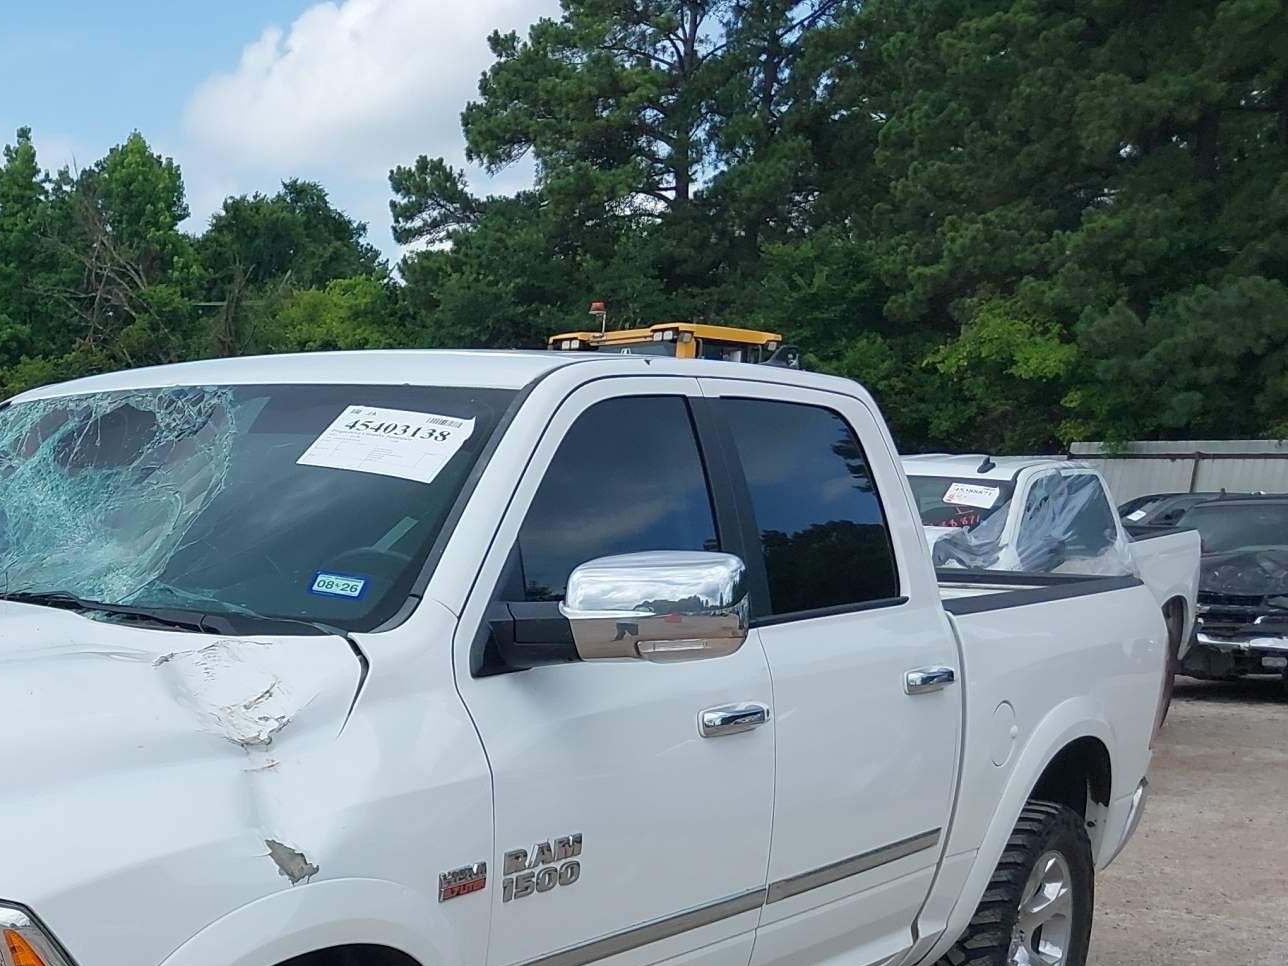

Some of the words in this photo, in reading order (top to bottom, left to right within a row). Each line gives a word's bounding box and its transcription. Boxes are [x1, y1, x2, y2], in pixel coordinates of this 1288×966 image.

[344, 419, 452, 441] 45403138
[503, 832, 582, 876] RAM
[502, 860, 581, 904] 1500
